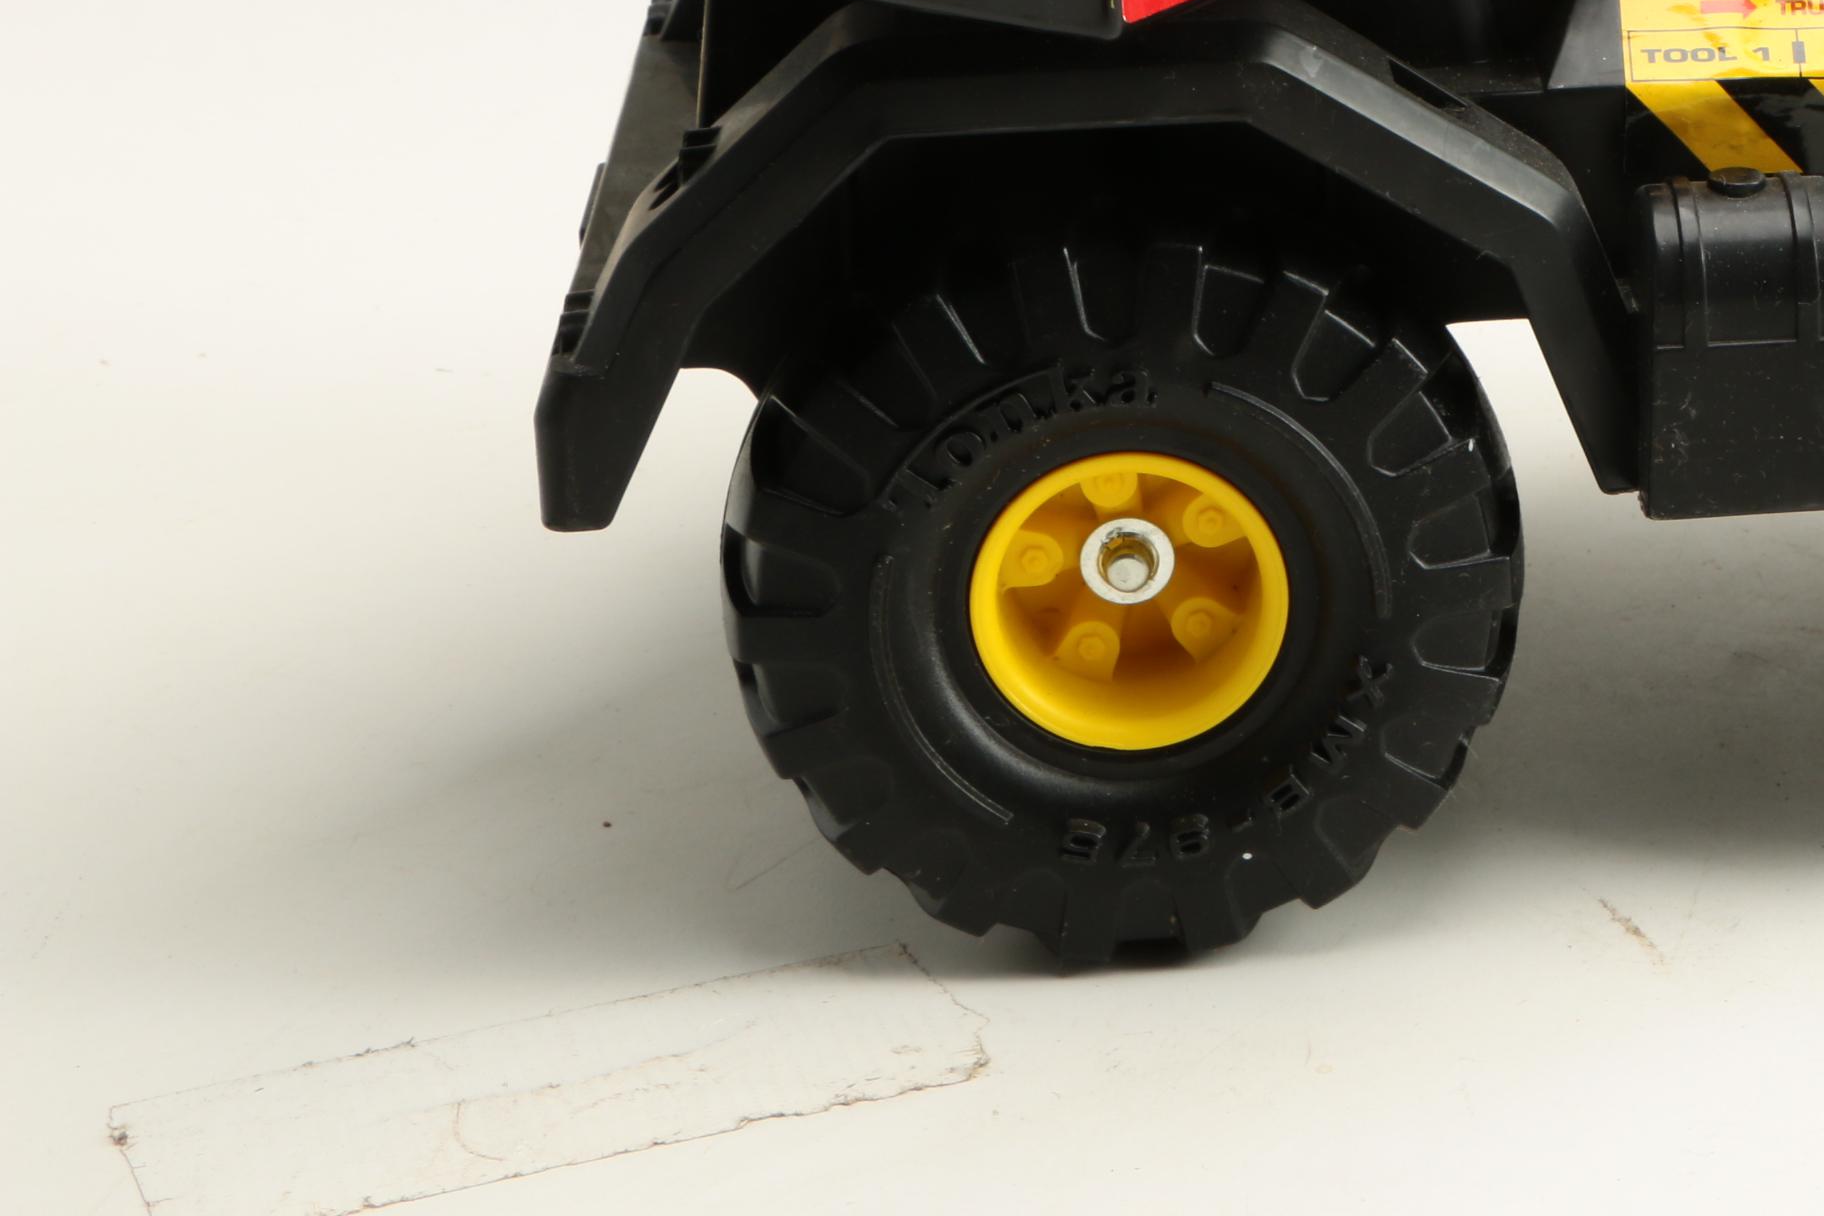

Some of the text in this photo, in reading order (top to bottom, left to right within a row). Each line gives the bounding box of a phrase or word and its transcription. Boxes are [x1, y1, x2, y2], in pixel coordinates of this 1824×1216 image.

[1640, 45, 1738, 65] TOOL
[1753, 45, 1771, 63] 1
[877, 359, 1160, 512] Tonka
